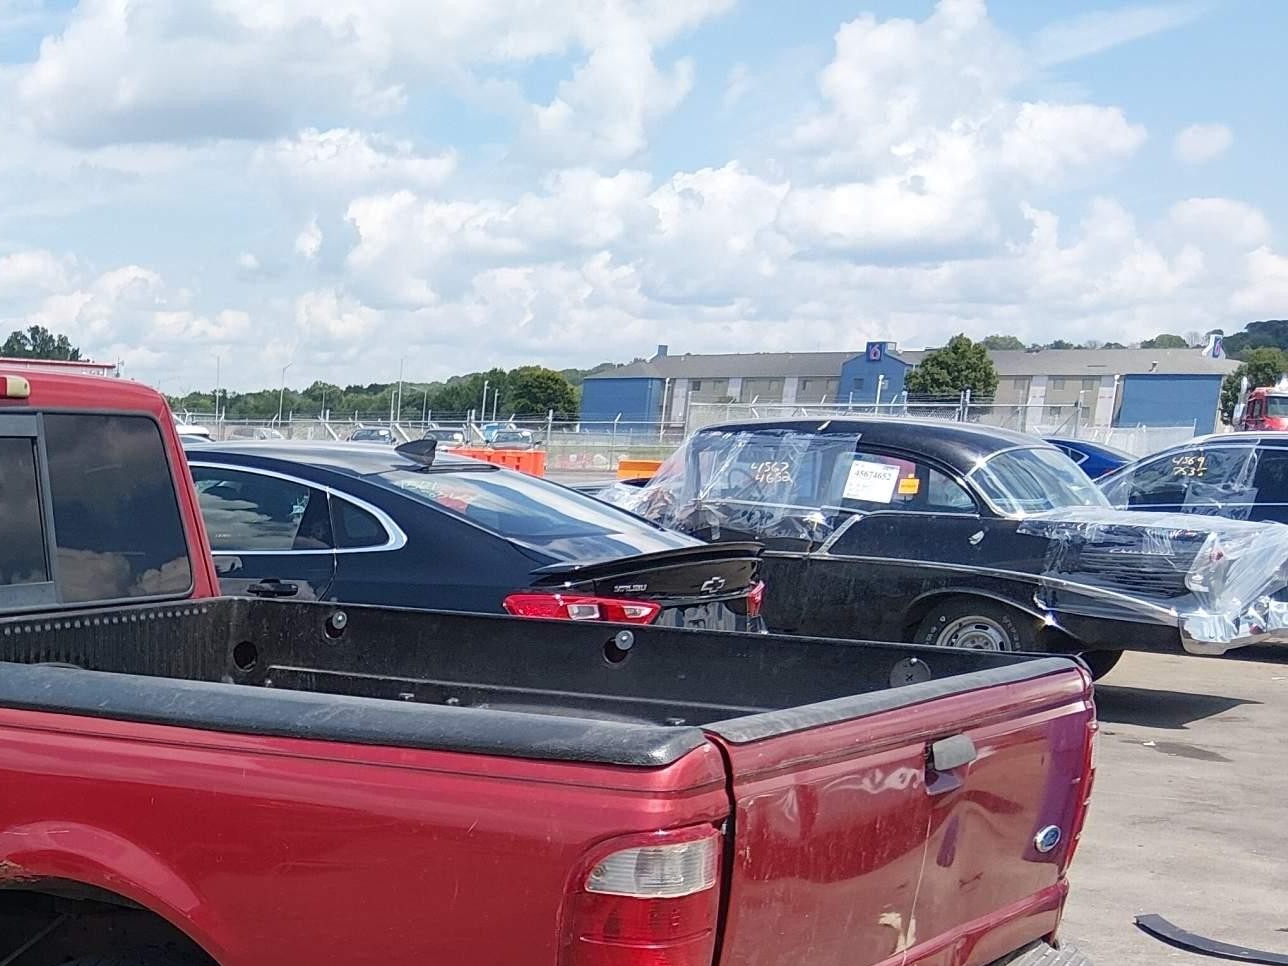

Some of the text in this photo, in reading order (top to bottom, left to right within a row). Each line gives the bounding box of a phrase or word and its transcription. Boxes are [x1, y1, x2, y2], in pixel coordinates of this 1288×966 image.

[750, 461, 789, 473] 4567
[755, 471, 793, 484] 4652
[854, 470, 892, 481] 45674652
